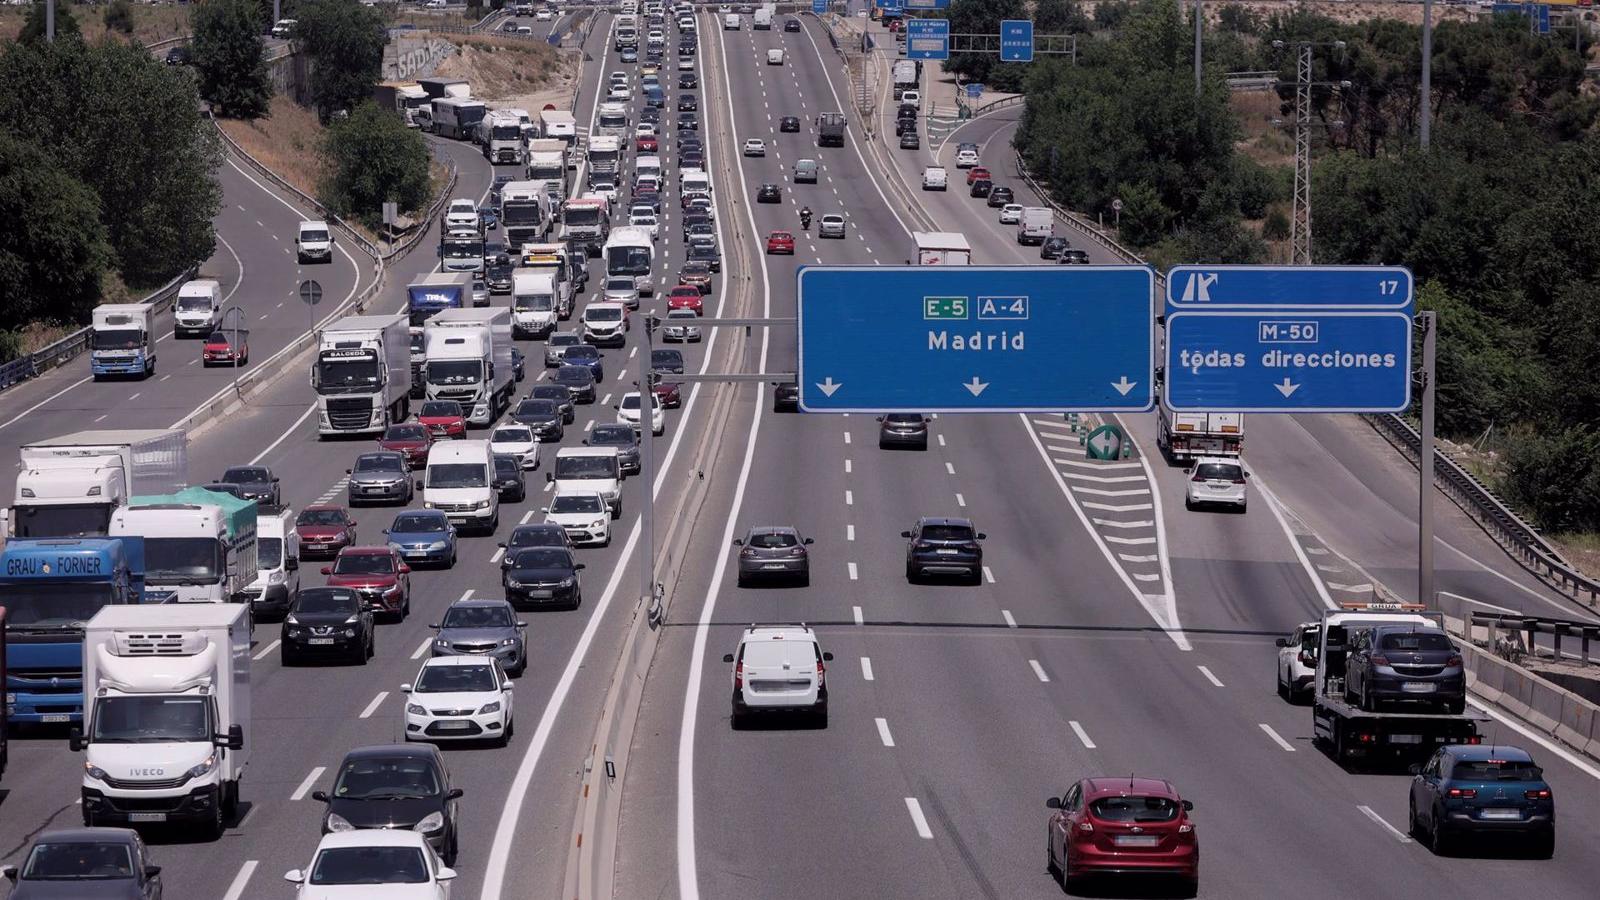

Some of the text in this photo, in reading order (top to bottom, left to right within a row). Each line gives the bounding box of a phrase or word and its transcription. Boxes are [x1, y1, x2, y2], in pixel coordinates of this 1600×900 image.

[1379, 280, 1399, 296] 17
[926, 298, 1025, 317] E-5 A-4
[928, 331, 1024, 350] Madrid
[1261, 324, 1315, 341] M-50
[1180, 350, 1396, 368] todas direcciones
[7, 557, 101, 576] GRAU FORNER
[130, 768, 164, 777] IVECO
